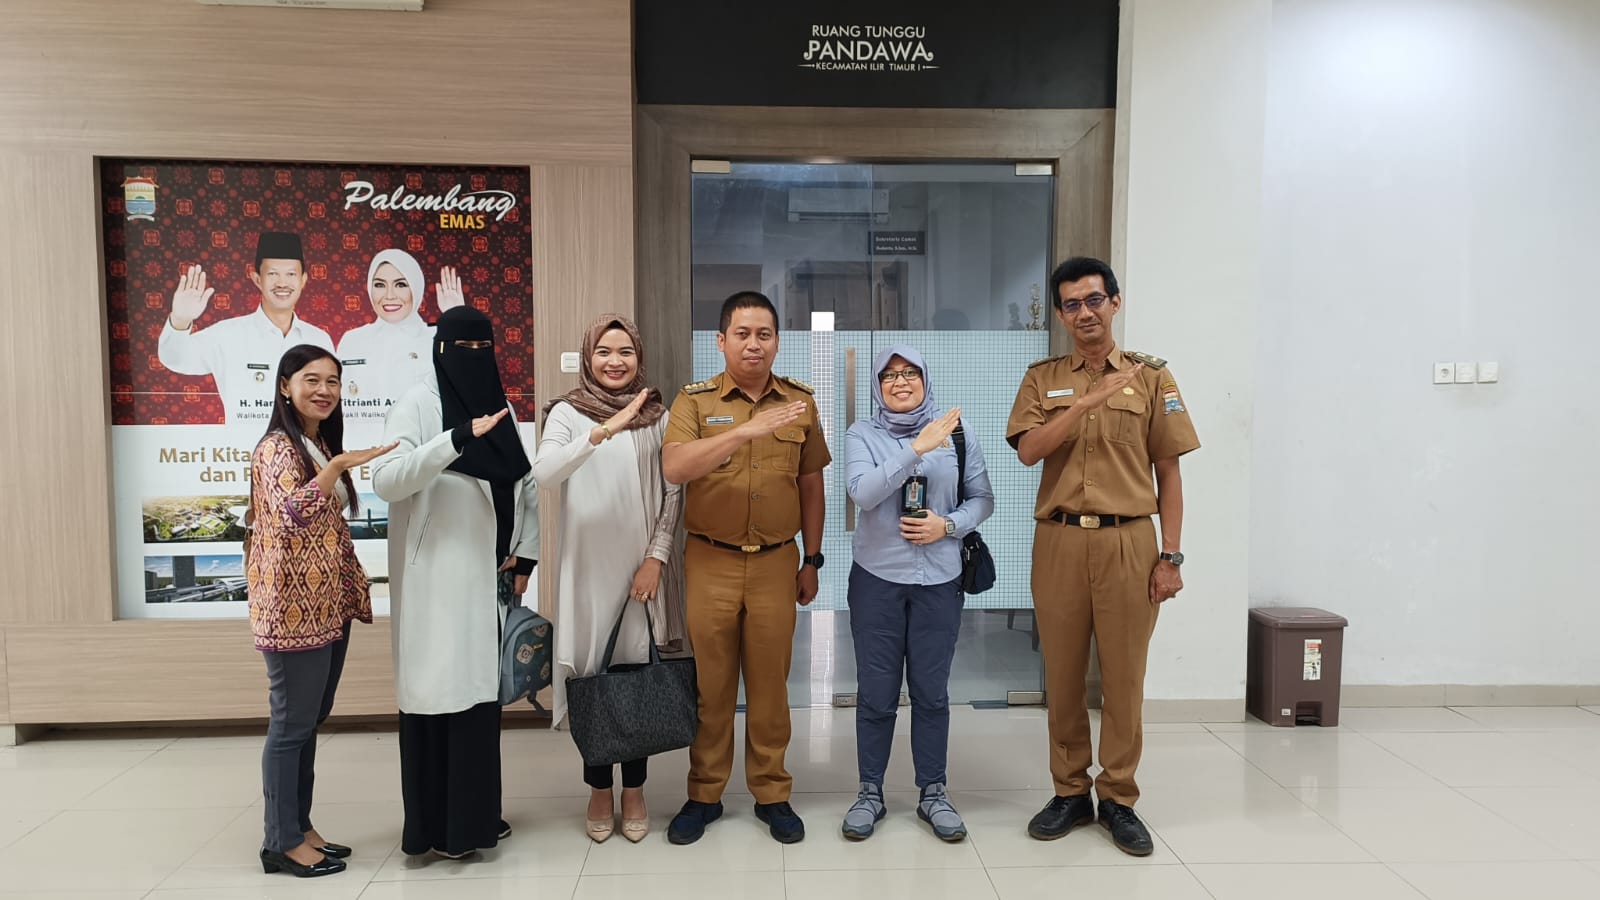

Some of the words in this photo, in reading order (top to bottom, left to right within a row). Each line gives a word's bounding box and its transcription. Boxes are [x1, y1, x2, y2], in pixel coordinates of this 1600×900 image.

[812, 24, 861, 38] RUANG
[864, 25, 925, 39] TUNGGU
[803, 39, 934, 61] PANDAWA
[815, 62, 867, 71] KECAMATAN
[870, 63, 885, 71] ILIR
[889, 63, 915, 72] TIMUR
[344, 180, 516, 222] Palembang
[439, 214, 486, 229] EMAS
[239, 399, 251, 408] H.
[255, 399, 274, 408] Har
[342, 398, 381, 407] itrianti
[159, 446, 206, 464] Mari
[212, 446, 252, 463] Kita
[199, 466, 237, 482] dan
